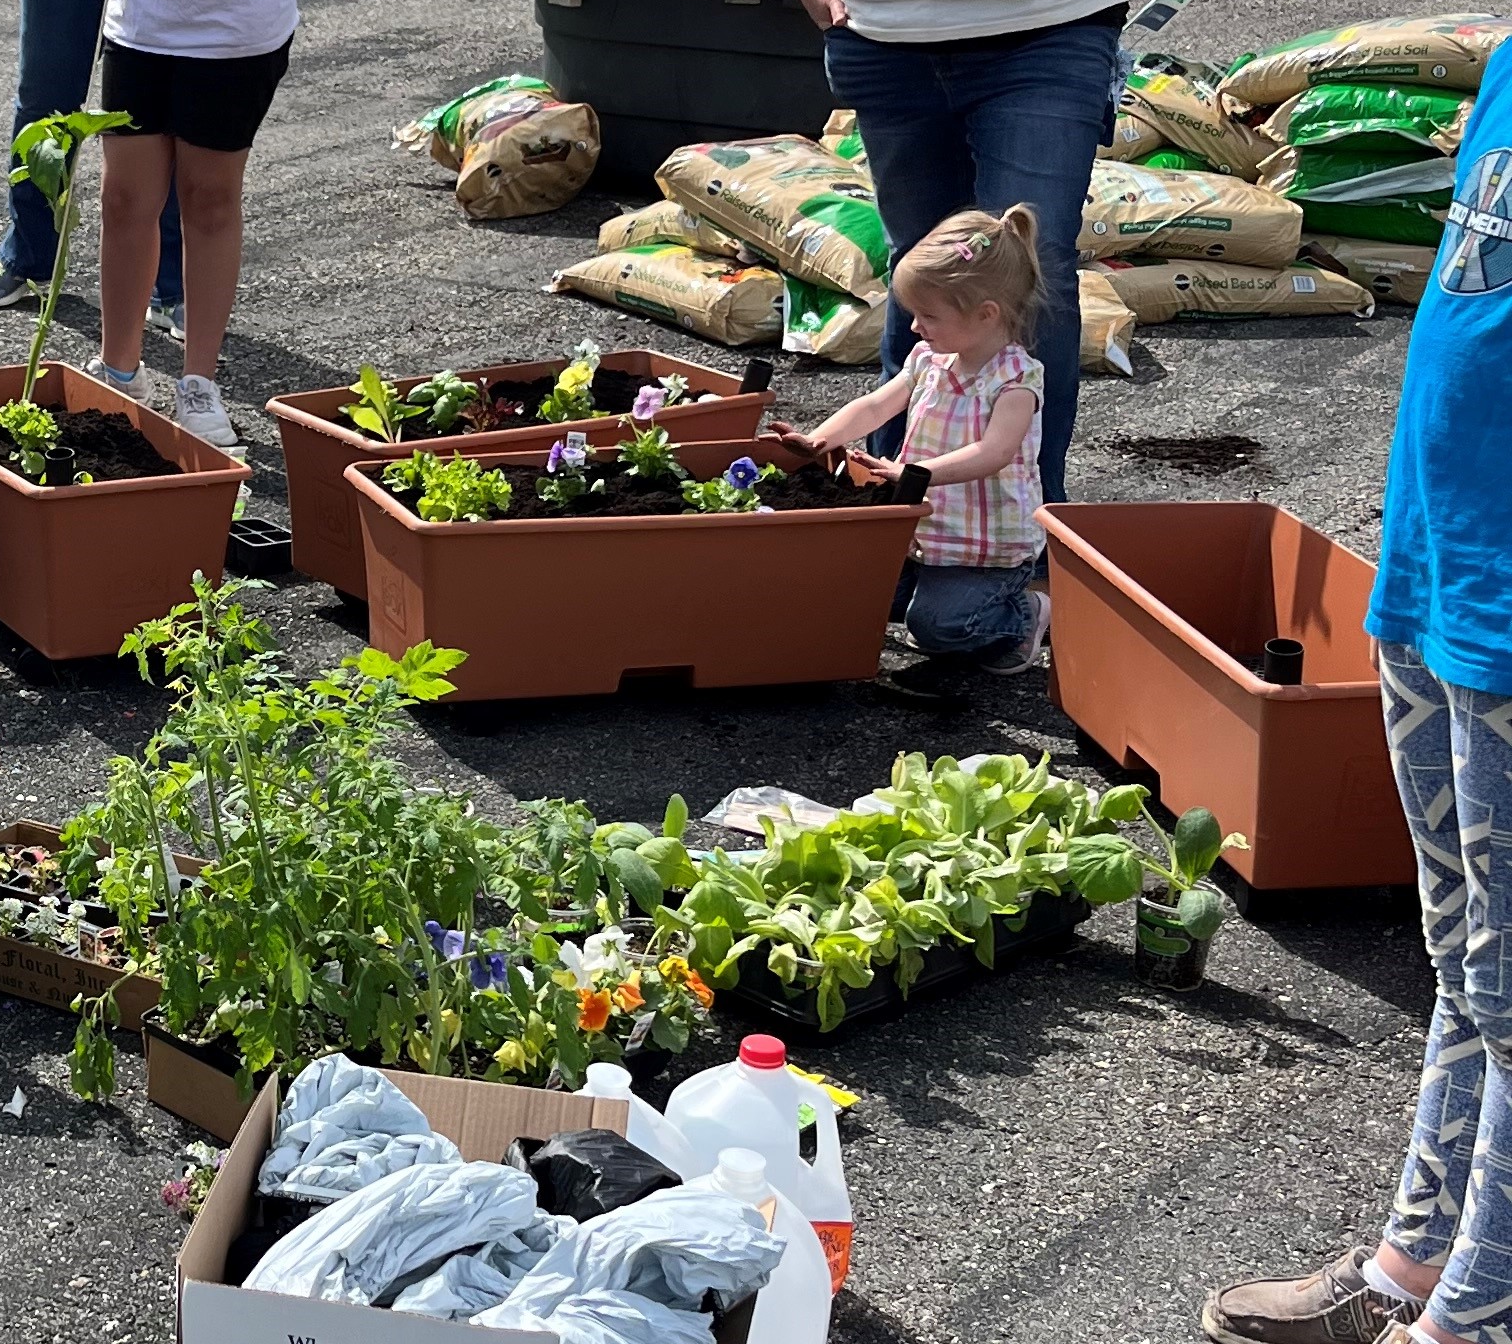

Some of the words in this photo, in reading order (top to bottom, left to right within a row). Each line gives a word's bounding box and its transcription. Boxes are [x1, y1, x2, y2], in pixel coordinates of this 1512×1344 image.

[1373, 45, 1401, 56] Bed
[1403, 44, 1430, 55] Soil
[1176, 111, 1201, 131] Bed
[1203, 122, 1227, 139] Soil
[720, 188, 755, 214] Raised
[753, 207, 777, 227] Bed
[1192, 276, 1228, 290] Raised
[1231, 276, 1256, 290] Bed
[1257, 276, 1277, 290] Soil
[29, 981, 40, 995] &
